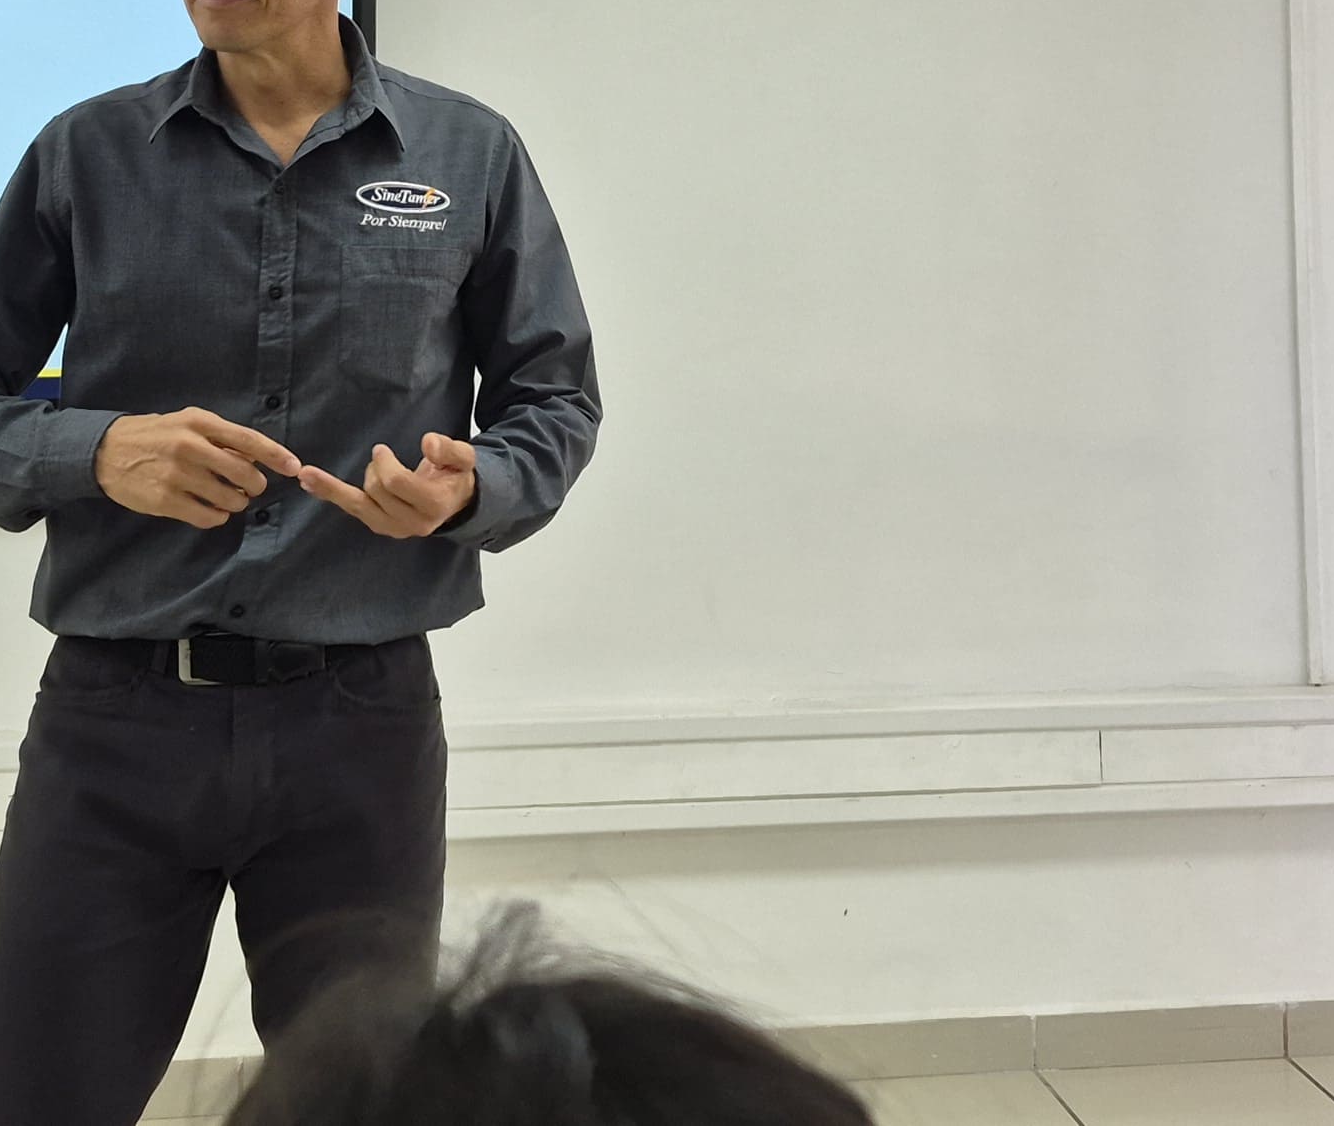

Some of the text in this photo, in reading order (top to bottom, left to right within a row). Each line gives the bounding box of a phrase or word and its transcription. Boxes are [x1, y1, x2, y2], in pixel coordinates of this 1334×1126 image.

[370, 187, 441, 205] SineTamer
[360, 213, 447, 232] Por Siempre!
